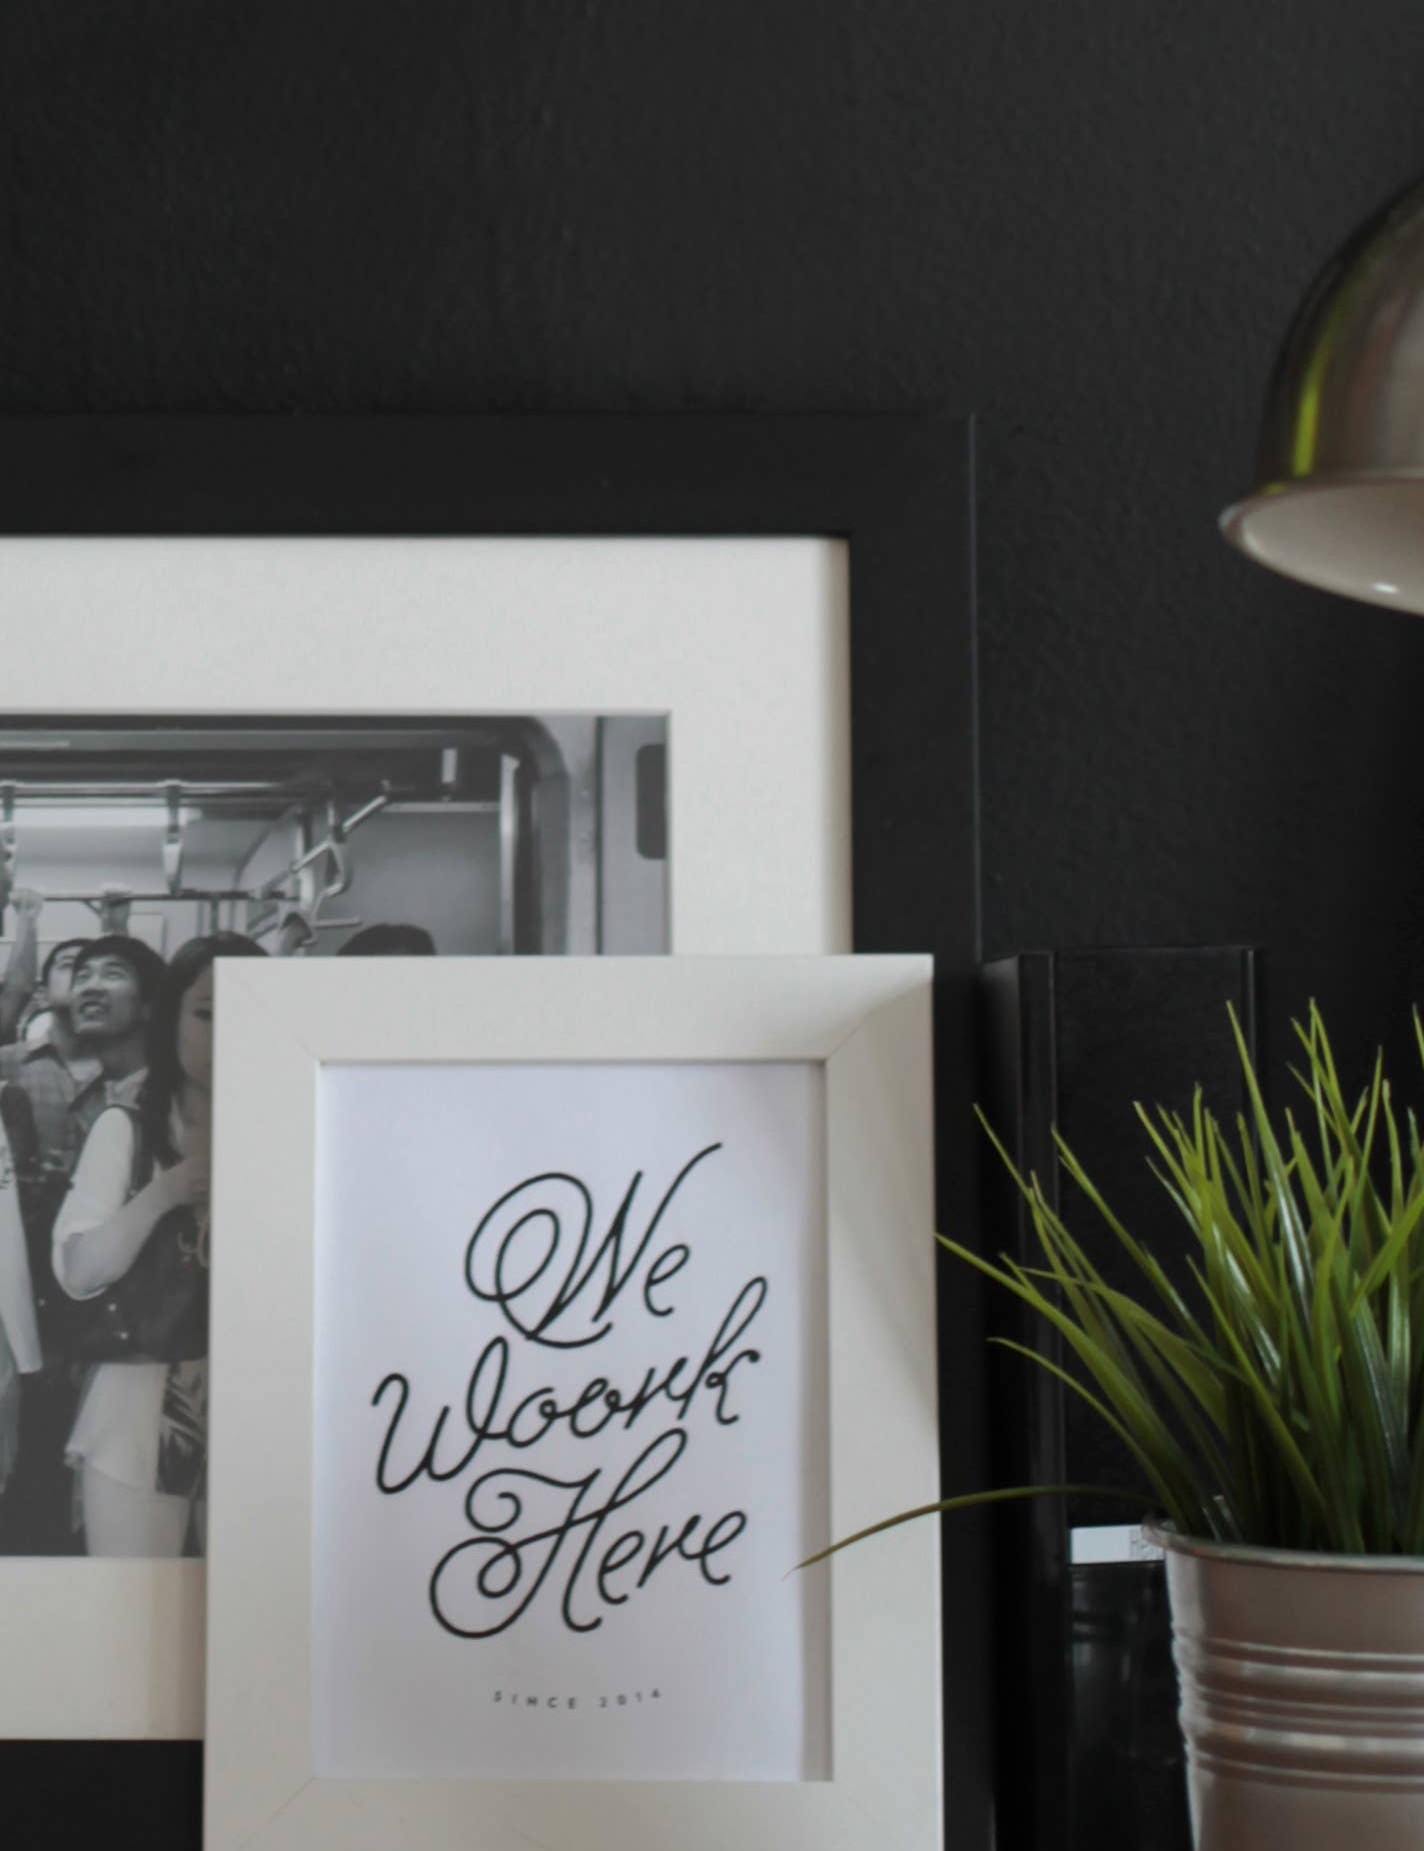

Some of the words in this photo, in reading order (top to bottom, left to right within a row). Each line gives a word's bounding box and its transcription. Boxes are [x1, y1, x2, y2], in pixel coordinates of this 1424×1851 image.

[464, 1140, 723, 1351] We
[427, 1426, 748, 1641] Here
[492, 1689, 577, 1710] SINCE
[599, 1688, 662, 1709] 2014
